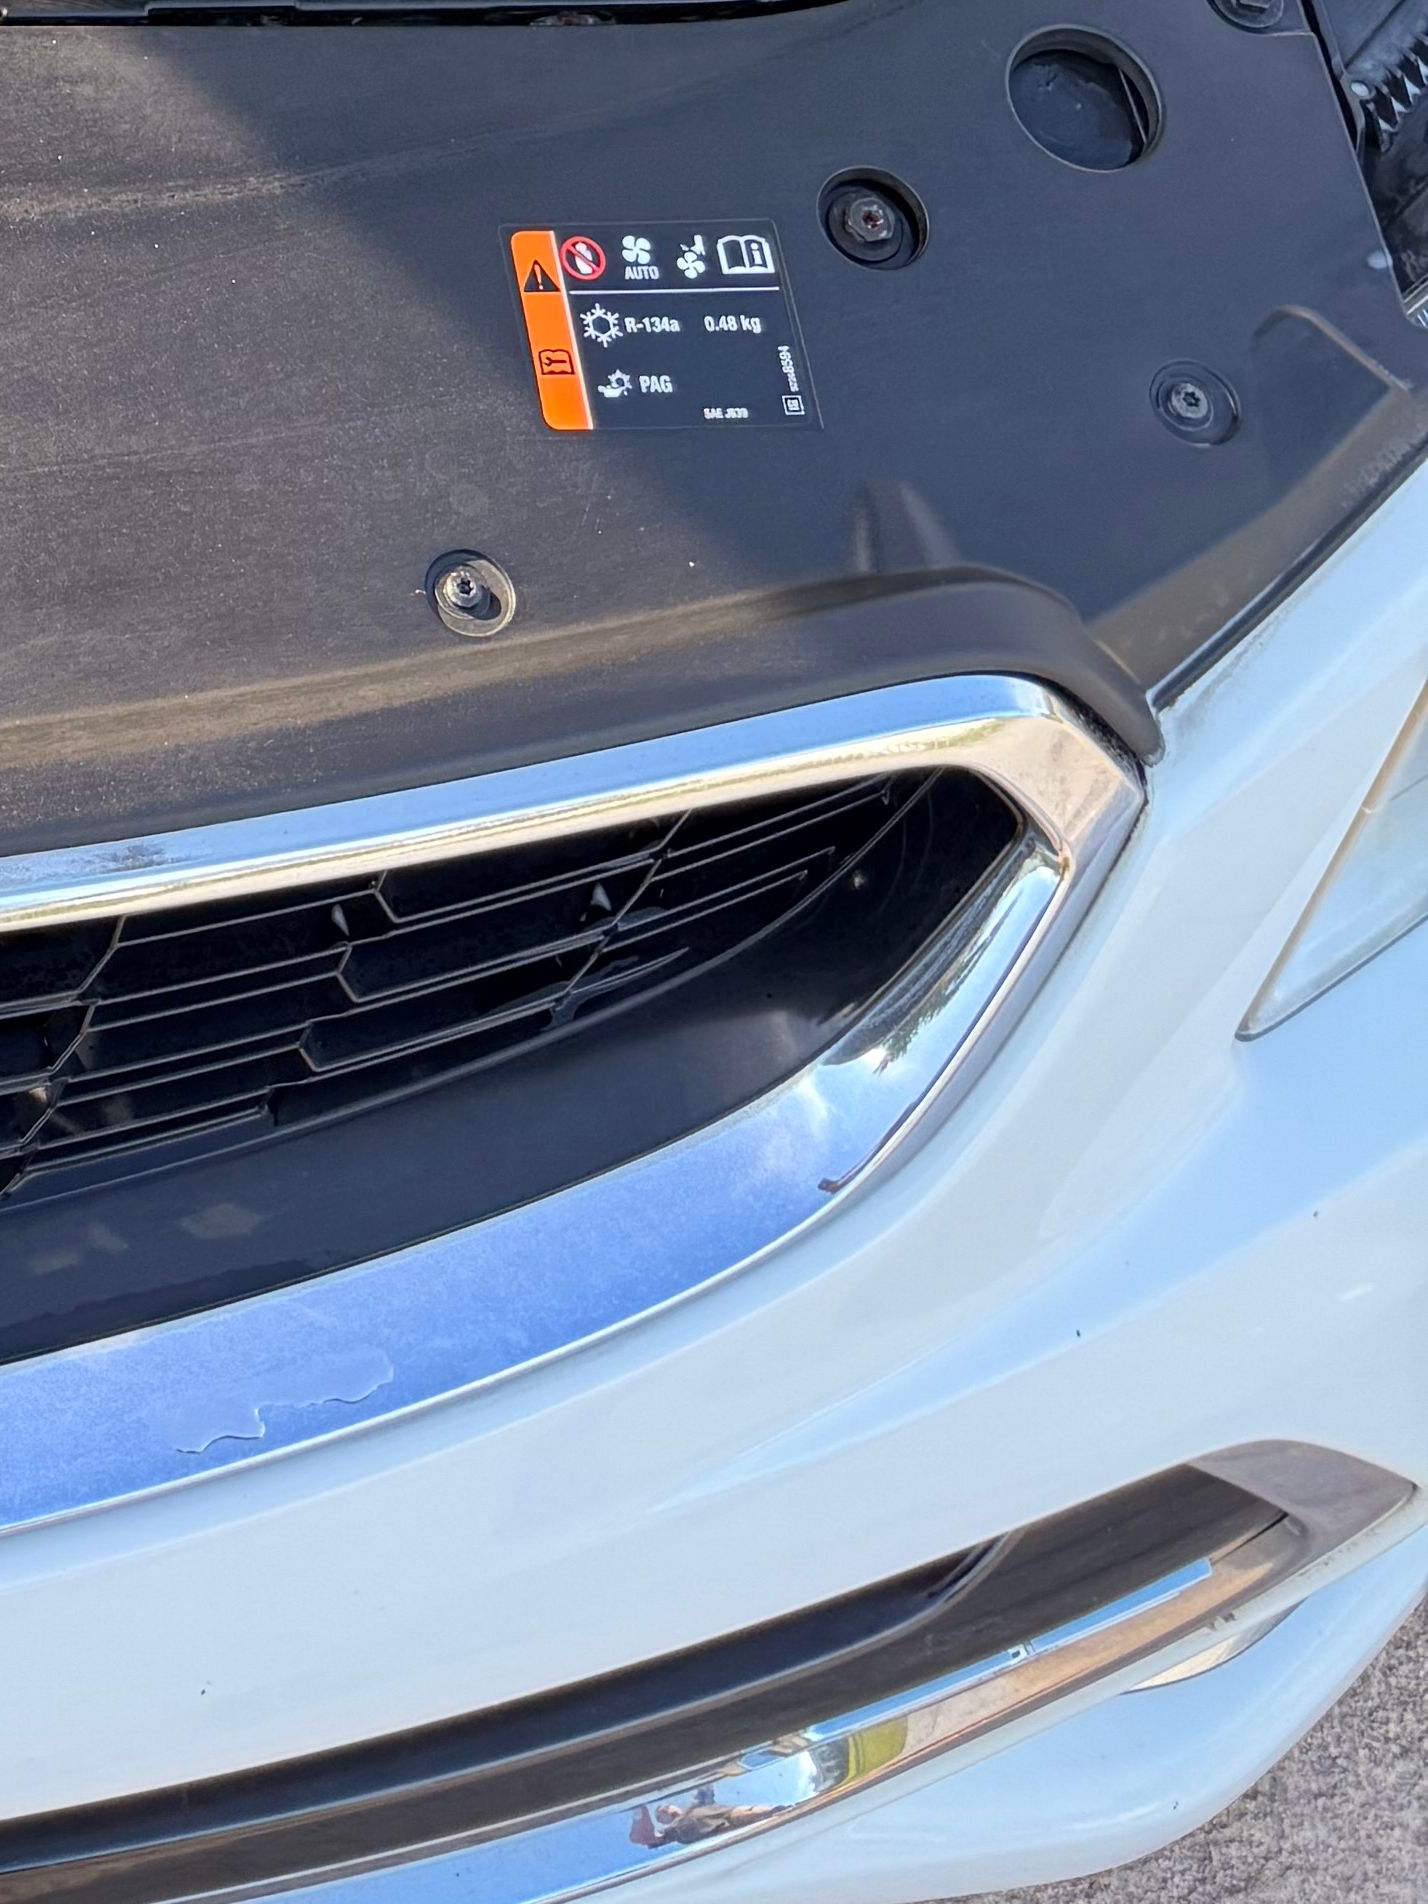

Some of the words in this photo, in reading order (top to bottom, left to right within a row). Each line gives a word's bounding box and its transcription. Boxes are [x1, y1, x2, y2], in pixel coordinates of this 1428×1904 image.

[624, 266, 660, 280] AUTO
[624, 317, 681, 334] R-134a
[704, 316, 738, 333] 0.48
[740, 315, 762, 334] kg
[639, 375, 674, 394] PAG
